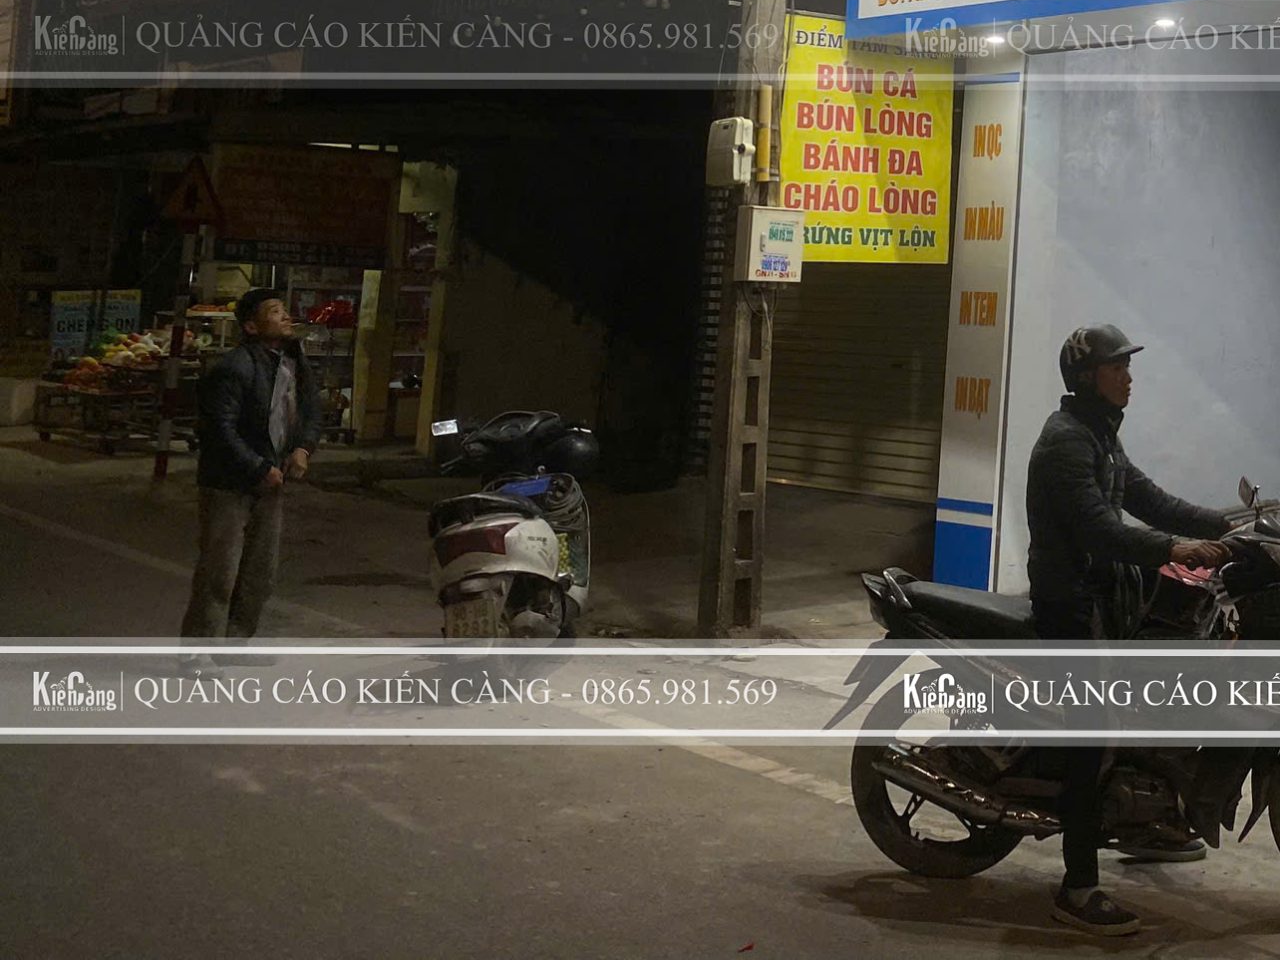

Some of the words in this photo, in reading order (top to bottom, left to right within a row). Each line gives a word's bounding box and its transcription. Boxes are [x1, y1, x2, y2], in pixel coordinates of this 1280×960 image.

[795, 24, 843, 49] ĐIỂM
[816, 60, 874, 95] BÚN
[882, 67, 918, 99] CÁ
[796, 98, 855, 133] BÚN
[863, 102, 932, 139] LÒNG
[803, 138, 880, 174] BÁNH
[887, 148, 923, 176] ĐA
[783, 179, 860, 213] CHÁO
[868, 181, 937, 216] LÒNG
[858, 228, 894, 251] VỊT
[898, 224, 936, 252] LỘN
